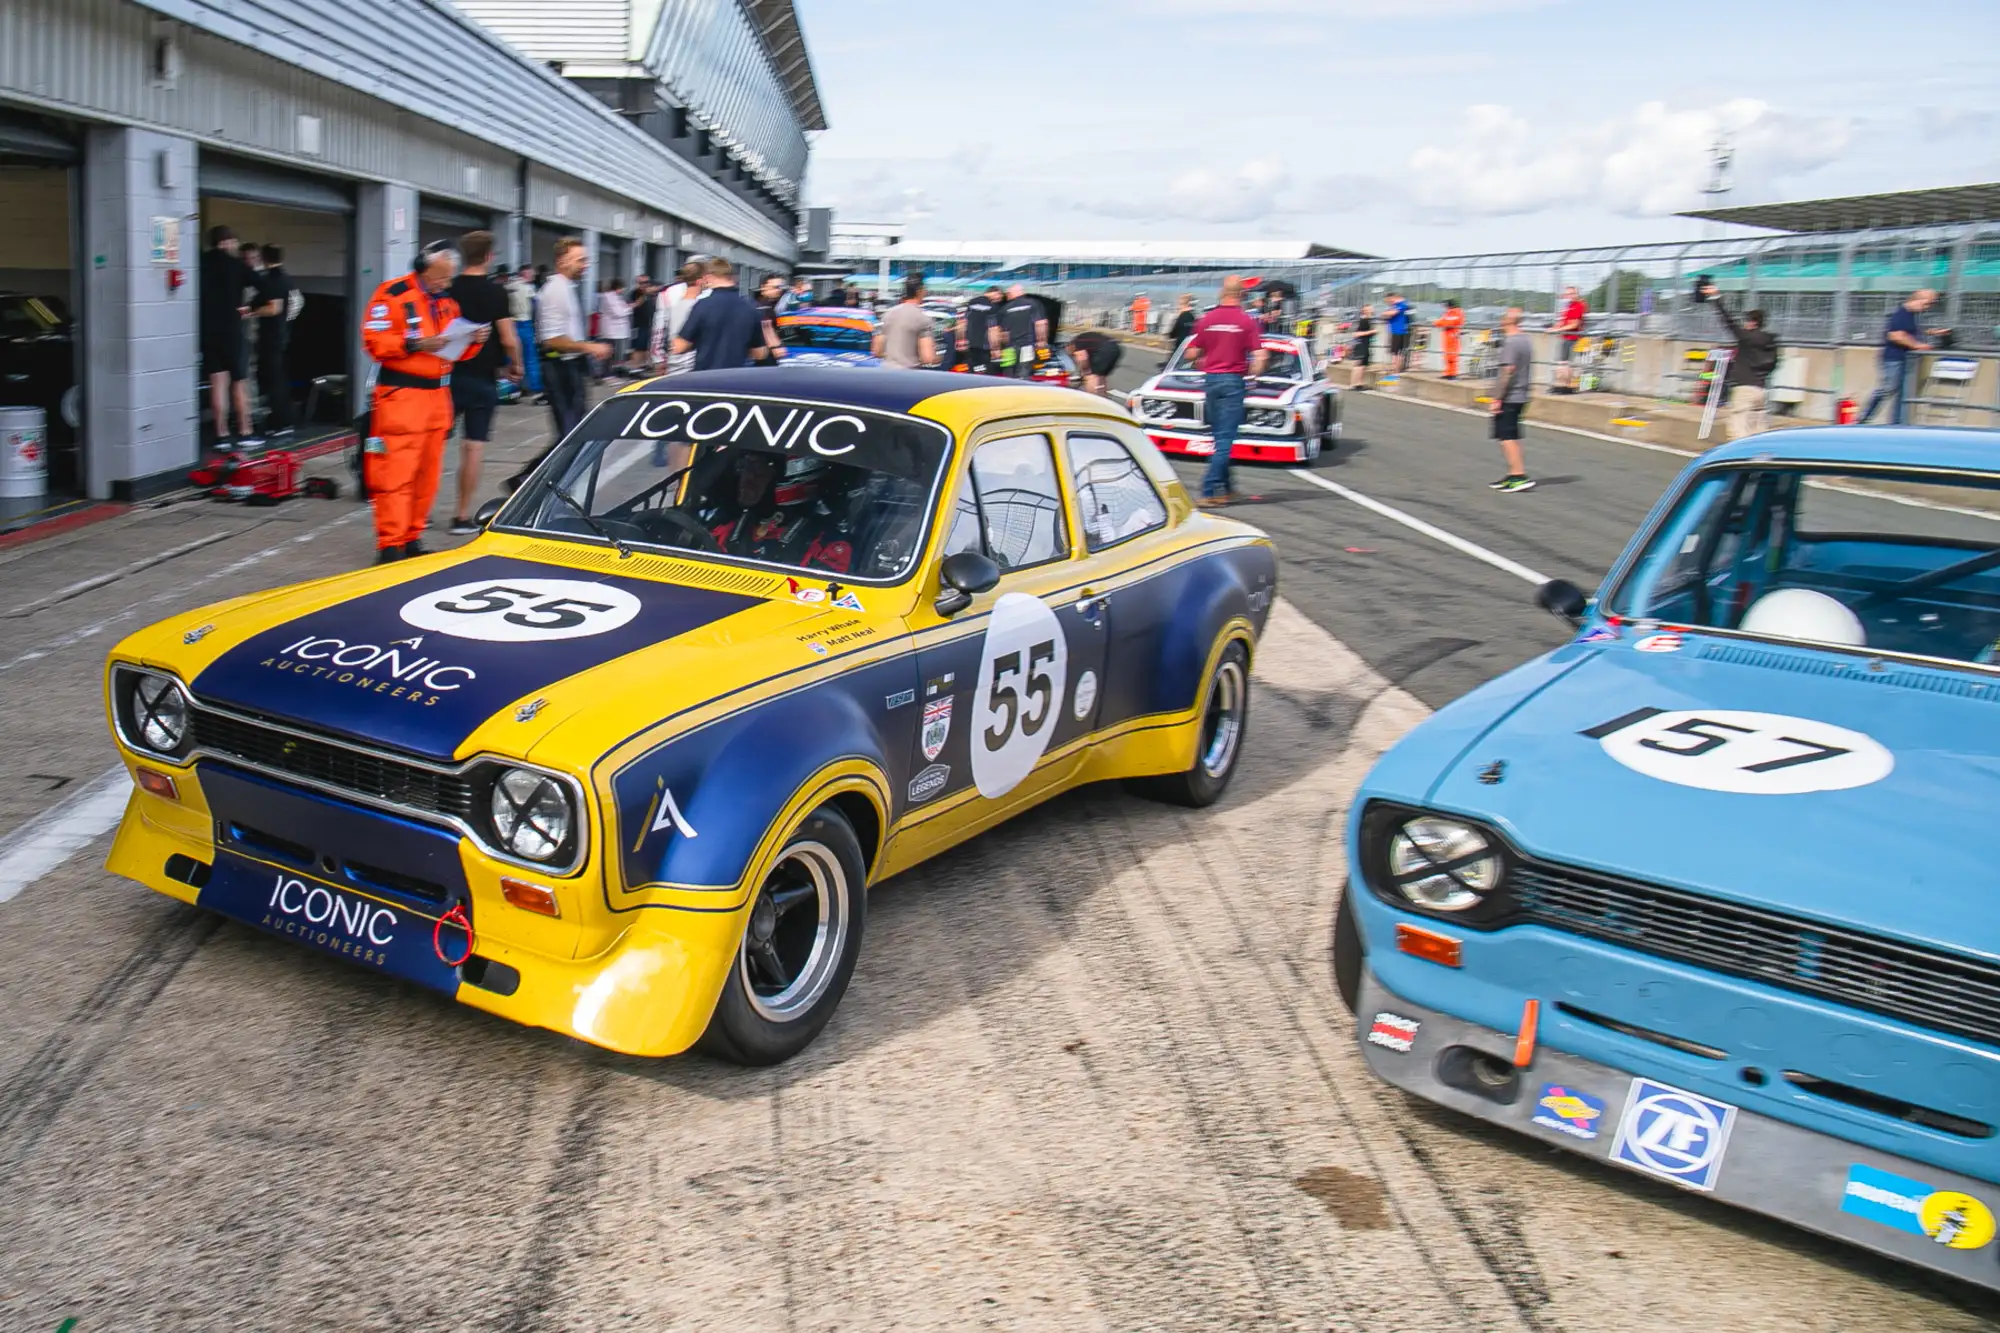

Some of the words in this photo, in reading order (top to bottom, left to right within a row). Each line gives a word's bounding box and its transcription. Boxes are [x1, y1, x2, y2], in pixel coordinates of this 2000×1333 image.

[621, 401, 866, 456] ICONIC
[434, 586, 616, 629] 55
[796, 628, 829, 642] Harry
[827, 619, 862, 632] Whale
[279, 635, 476, 691] ICONIC
[826, 634, 851, 647] Matt
[851, 627, 876, 640] Neal
[260, 657, 440, 706] AUCTIONEERS
[984, 639, 1054, 752] 55
[1576, 706, 1851, 773] 157
[269, 875, 398, 945] ICONIC
[262, 914, 388, 965] AUCTIONEERS
[1636, 1101, 1717, 1163] ZF
